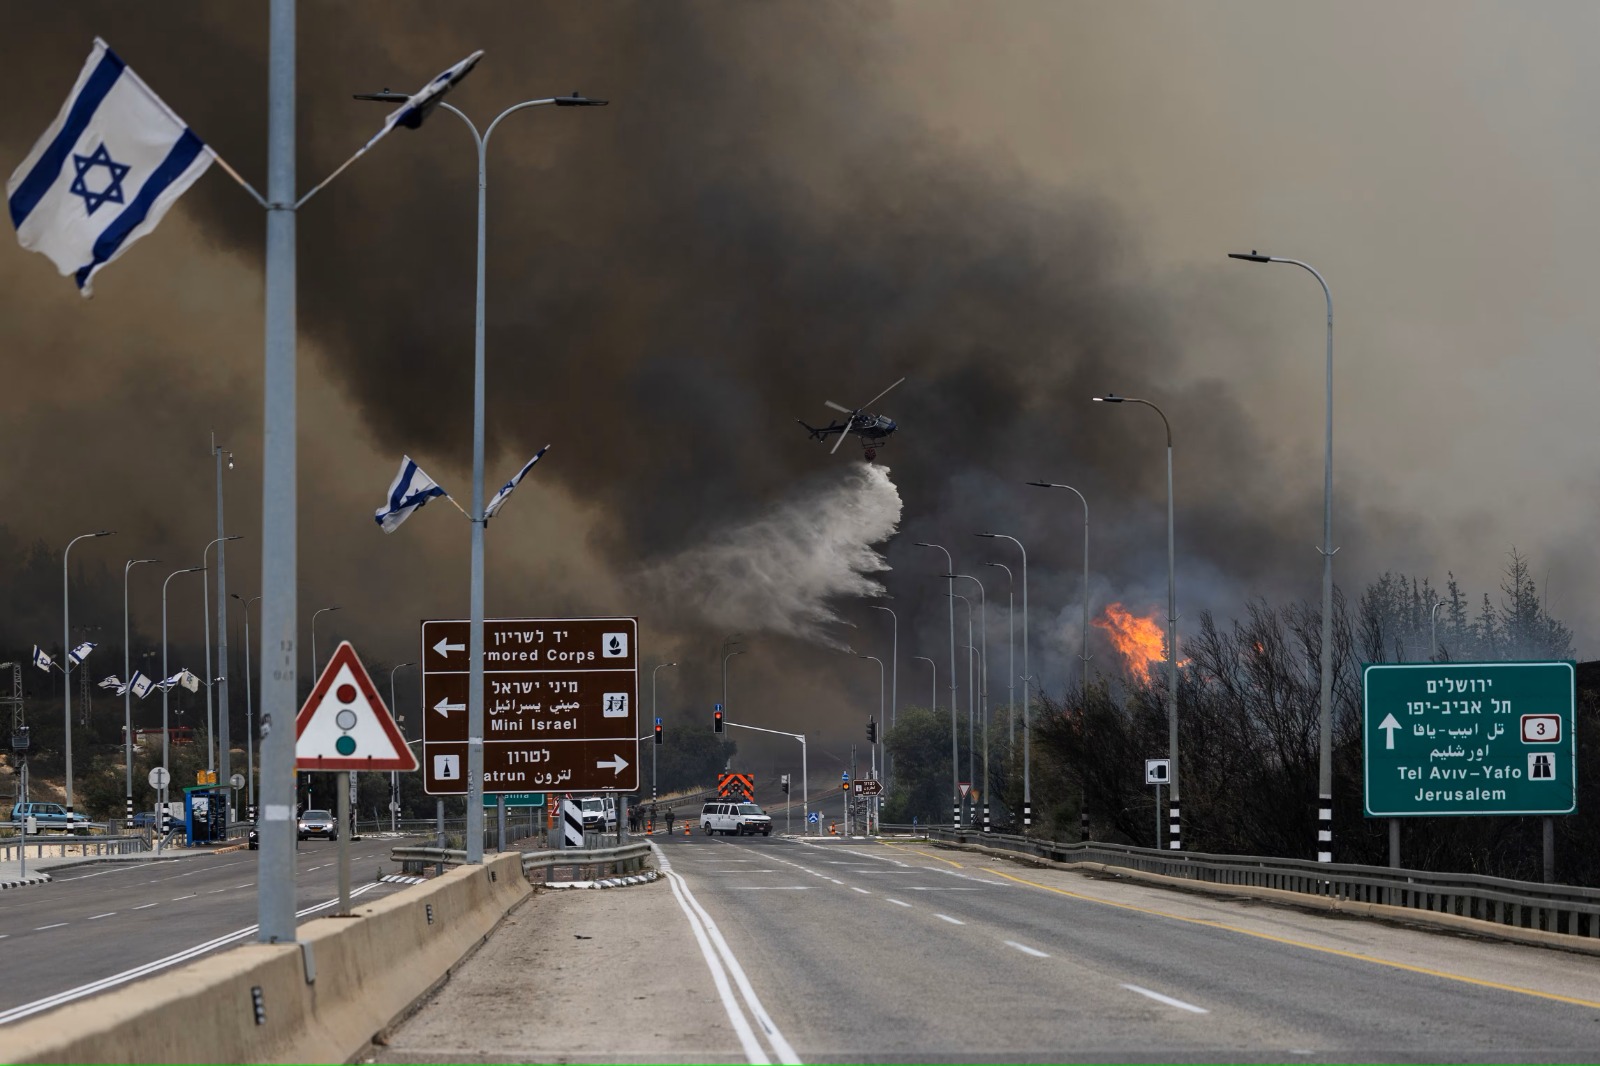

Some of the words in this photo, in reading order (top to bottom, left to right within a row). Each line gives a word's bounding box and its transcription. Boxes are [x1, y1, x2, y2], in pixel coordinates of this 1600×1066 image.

[494, 629, 544, 646] לשריון
[553, 631, 568, 643] יד
[547, 649, 595, 664] Corps
[492, 680, 540, 694] ישראל
[548, 681, 578, 693] מיני
[1426, 677, 1492, 693] ירושלים
[489, 699, 541, 715] يسرائيل
[549, 699, 580, 714] ميني
[1491, 698, 1511, 714] תל
[491, 718, 523, 731] Mini
[531, 718, 577, 730] Israel
[1487, 723, 1504, 740] تل
[1536, 723, 1545, 736] 3
[507, 748, 550, 765] לטרון
[483, 771, 526, 781] atrun
[534, 769, 572, 784] لترون
[1397, 767, 1422, 780] Tel
[1414, 788, 1506, 801] Jerusalem
